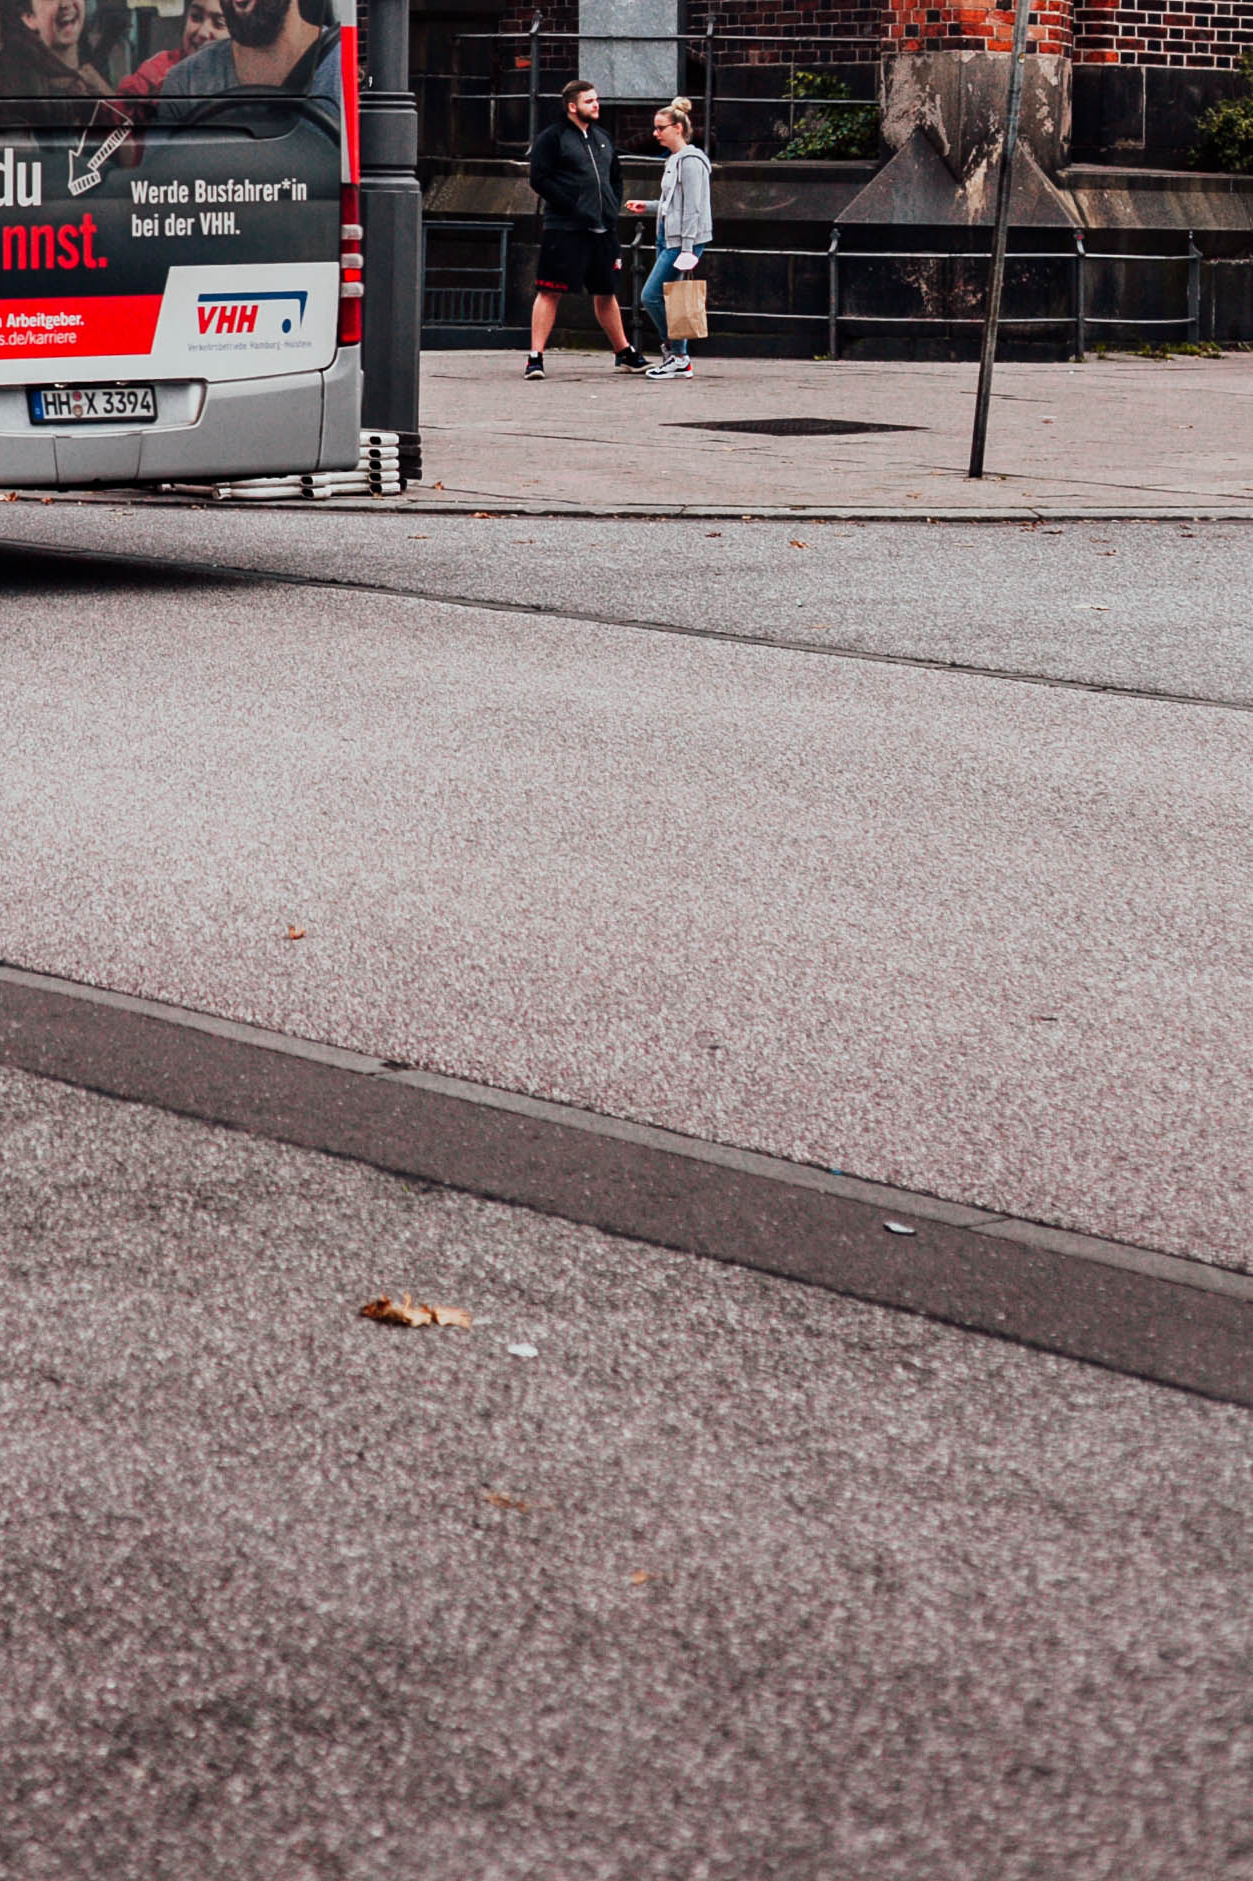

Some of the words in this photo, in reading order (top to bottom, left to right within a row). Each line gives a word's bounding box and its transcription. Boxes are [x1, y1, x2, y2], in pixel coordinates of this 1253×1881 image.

[130, 180, 189, 205] Werde
[131, 213, 159, 237] bei
[164, 212, 195, 237] der
[199, 211, 241, 236] VHH.
[6, 312, 85, 330] Arbeitgeber.
[197, 304, 259, 335] VHH
[43, 392, 72, 416] HH
[84, 391, 99, 415] X
[102, 391, 152, 414] 3394
